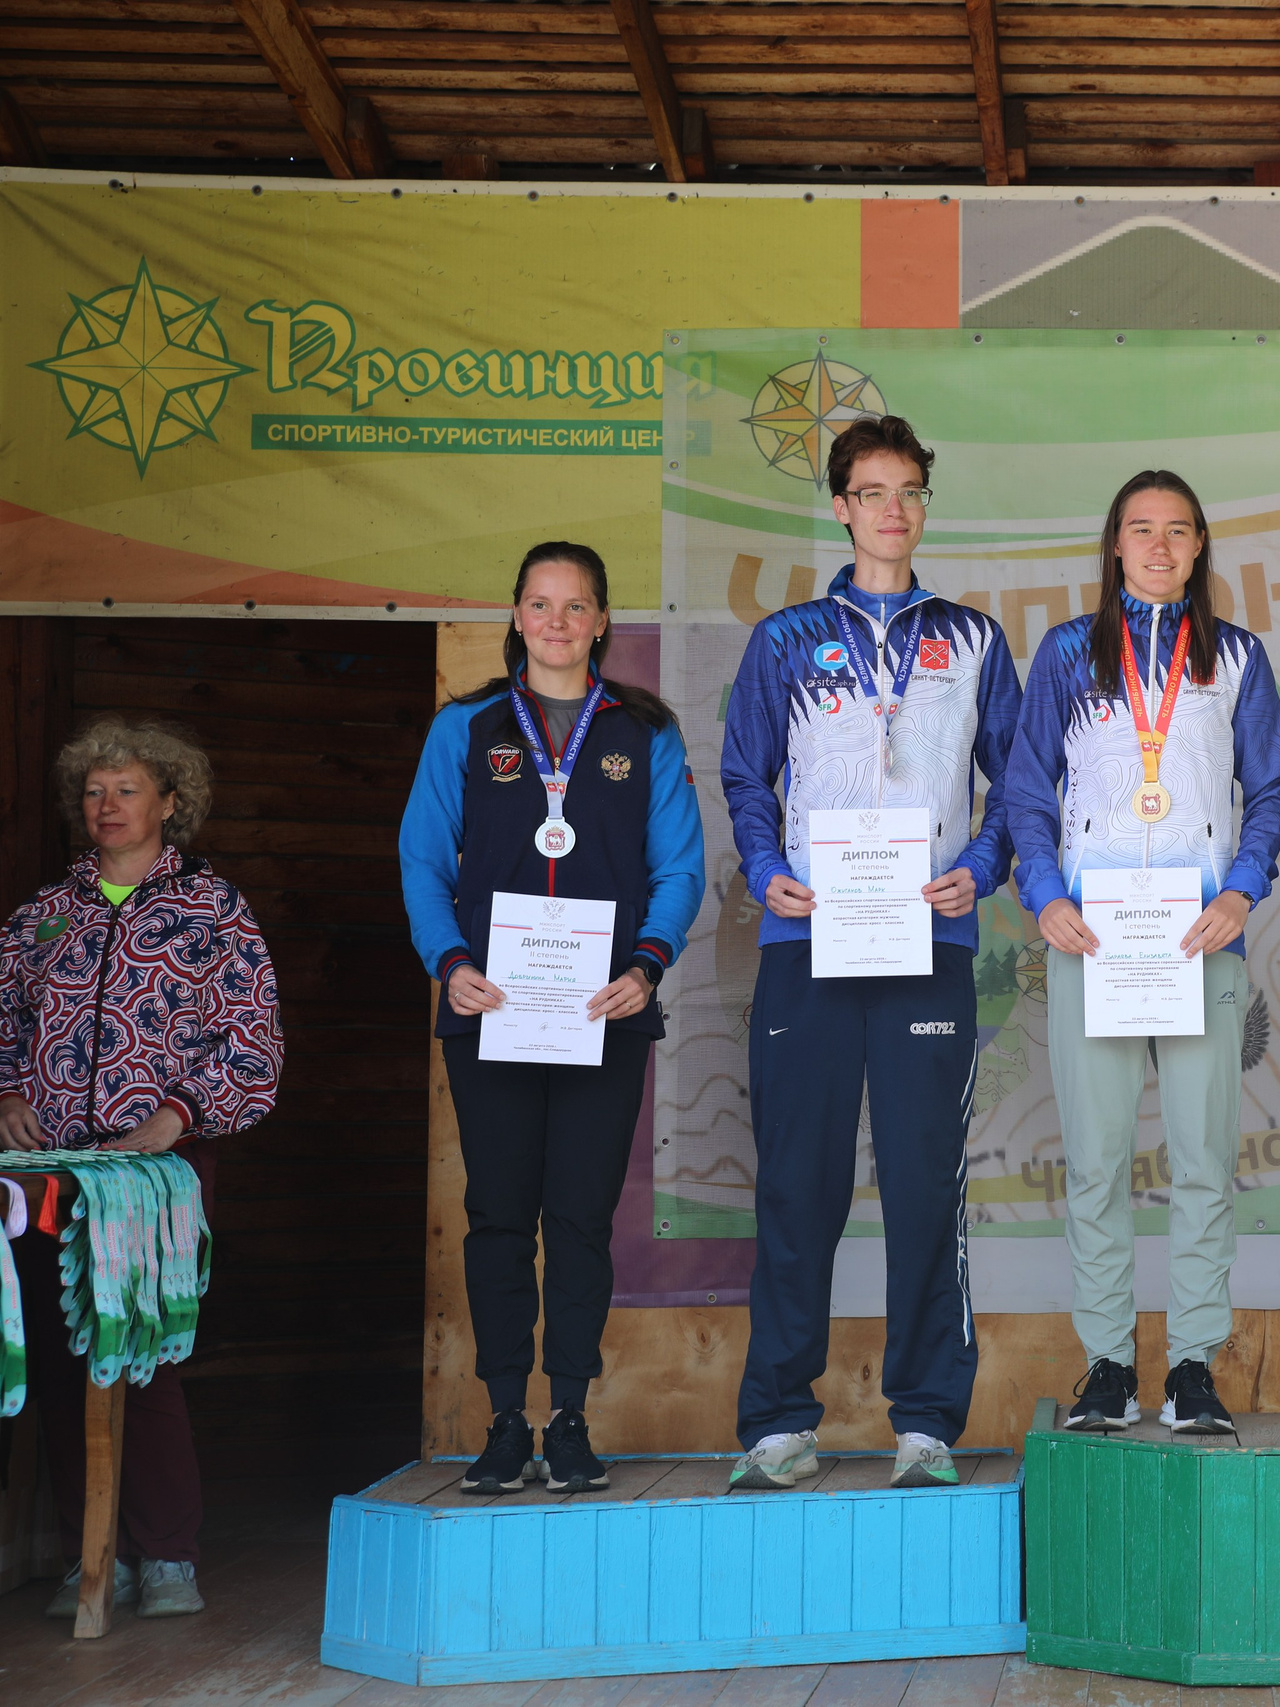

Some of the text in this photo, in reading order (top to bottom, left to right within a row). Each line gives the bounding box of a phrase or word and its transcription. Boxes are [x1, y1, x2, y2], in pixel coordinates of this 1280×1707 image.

[267, 422, 615, 448] СПОРТИВНО-ТУРИСТИЧЕСКИЙ
[842, 850, 899, 861] ДИПЛОМ
[1114, 909, 1171, 920] ДИПЛОМ
[521, 937, 581, 951] ДИПЛОМ
